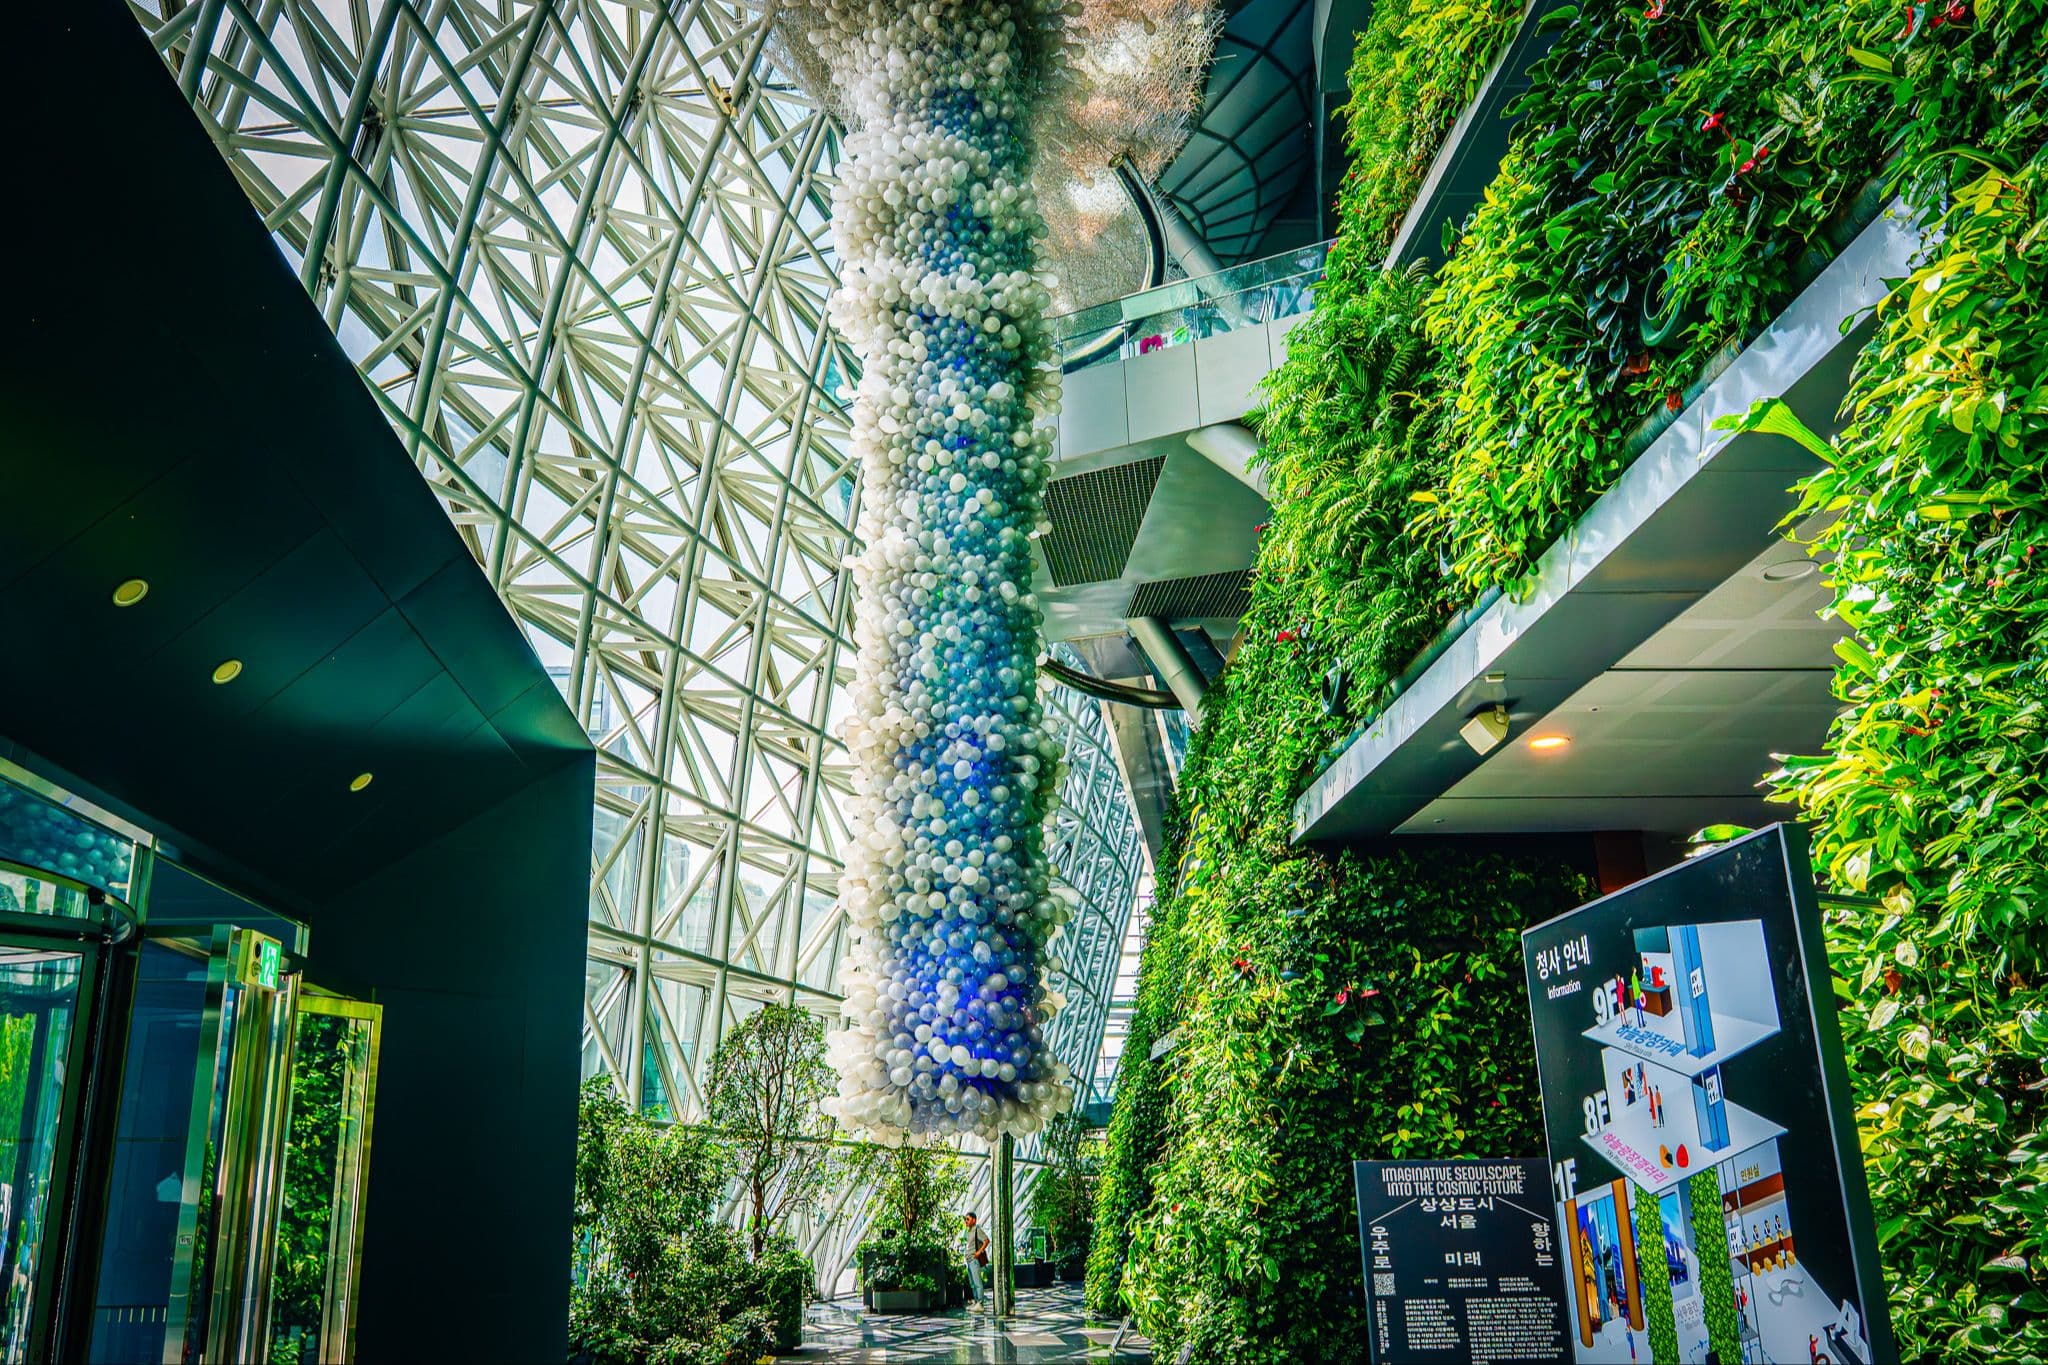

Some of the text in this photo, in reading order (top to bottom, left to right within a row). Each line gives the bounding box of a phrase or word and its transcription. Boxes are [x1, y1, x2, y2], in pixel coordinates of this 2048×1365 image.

[1536, 934, 1590, 980] 청사 안내
[1547, 980, 1581, 1000] Information
[1592, 978, 1618, 1027] 9F
[1616, 1024, 1686, 1057] 하늘광장카페
[1583, 1089, 1609, 1137] 8F
[1381, 1165, 1527, 1183] IMAGINATIVE SEOULSCAPE:
[1603, 1132, 1669, 1185] 하늘광장갤러리
[1387, 1179, 1525, 1197] INTO THE COSMIC FUTURE
[1554, 1158, 1577, 1202] 1F
[1420, 1196, 1495, 1213] 상상도시
[1440, 1214, 1478, 1230] 서울
[1370, 1226, 1392, 1270] 우주로
[1445, 1251, 1482, 1267] 미래
[1531, 1222, 1554, 1267] 향하는
